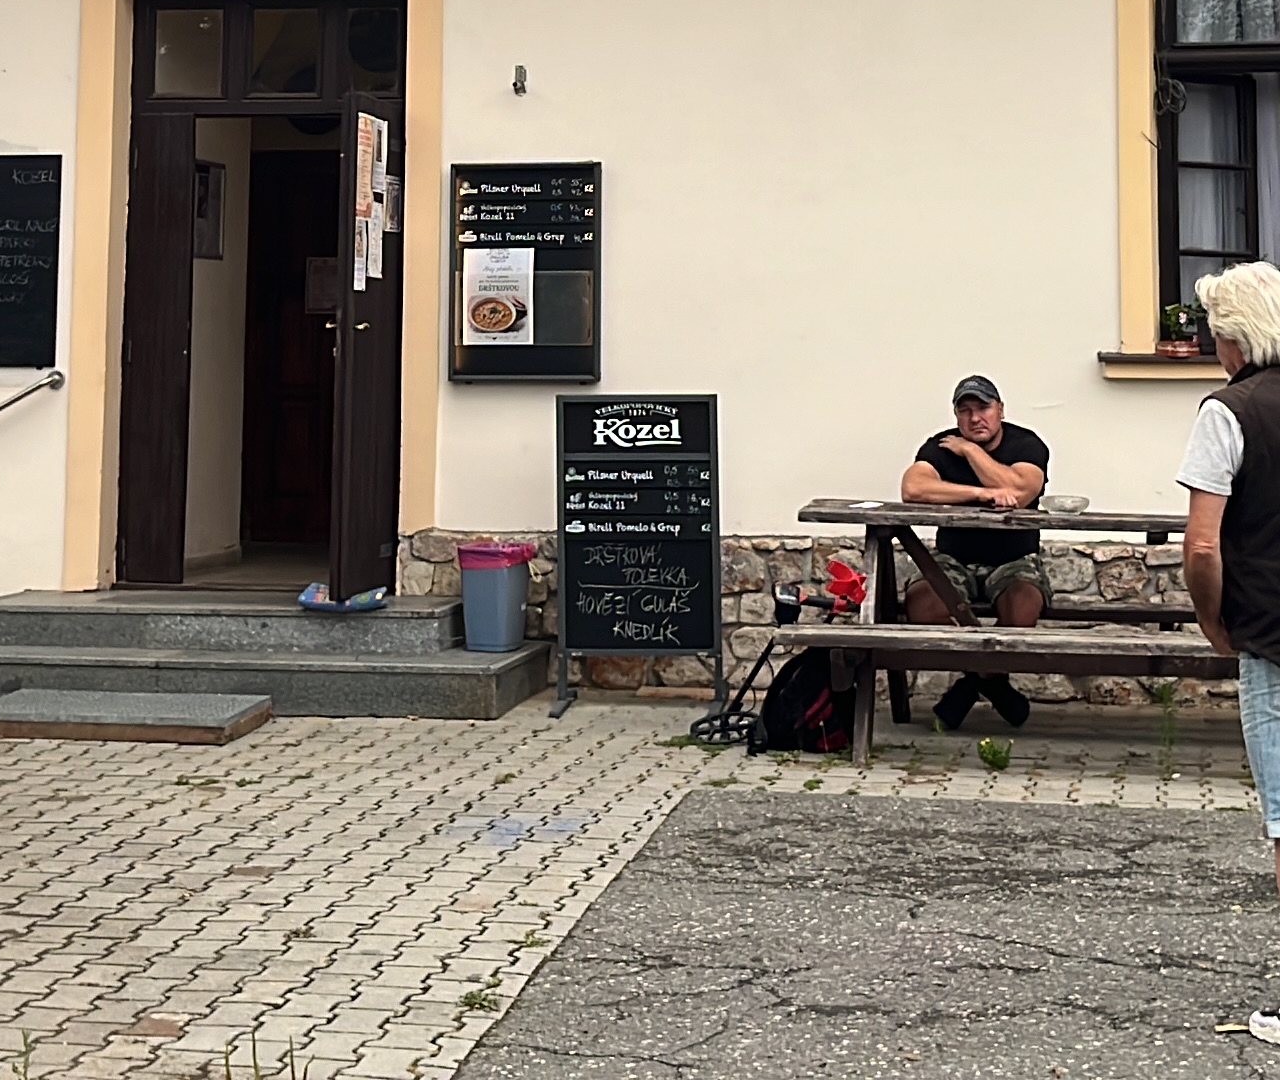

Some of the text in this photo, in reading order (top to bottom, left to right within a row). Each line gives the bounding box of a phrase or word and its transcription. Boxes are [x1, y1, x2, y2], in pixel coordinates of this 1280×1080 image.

[480, 184, 509, 193] Pilsner
[511, 184, 541, 197] Urquell
[480, 212, 503, 220] Kozel
[506, 212, 515, 220] 11
[480, 233, 502, 241] Birell
[506, 232, 535, 241] Pomelo
[543, 232, 565, 245] Grep
[593, 419, 682, 447] Kozel
[587, 470, 618, 480] Pilsner
[621, 470, 653, 484] Urquell
[588, 501, 612, 510] Kozel
[615, 501, 625, 510] 11
[588, 522, 613, 532] Birell
[616, 522, 649, 532] Pomelo
[657, 522, 680, 537] Grep
[612, 617, 681, 645] KNEDLÍK
